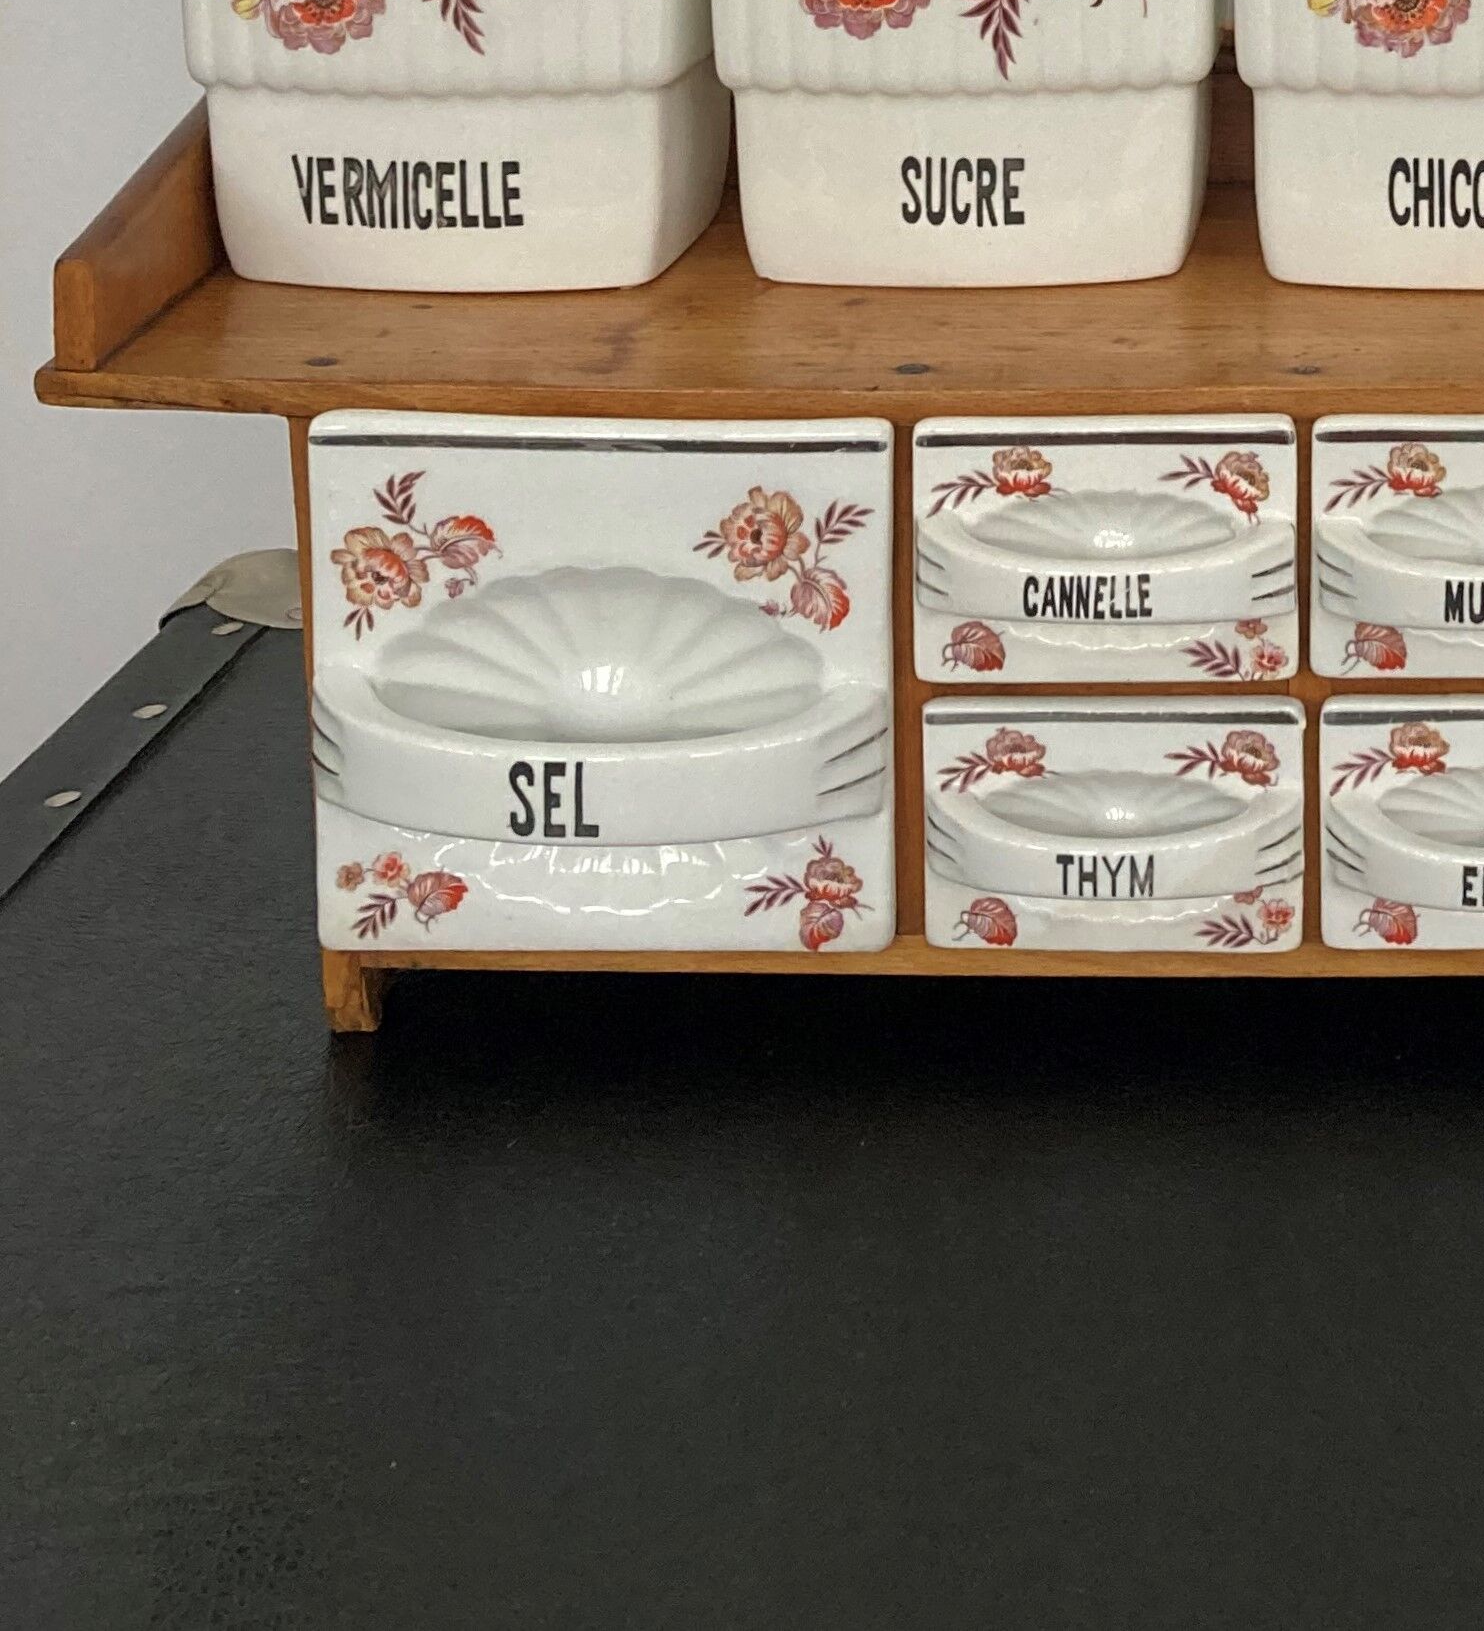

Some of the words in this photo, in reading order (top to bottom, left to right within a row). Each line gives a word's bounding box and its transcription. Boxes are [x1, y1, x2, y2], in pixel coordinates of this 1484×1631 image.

[291, 154, 524, 231] VERMICELLE
[901, 155, 1025, 228] SUCRE
[1023, 573, 1153, 620] CANNELLE
[508, 761, 600, 838] SEL
[1056, 854, 1154, 898] THYM
